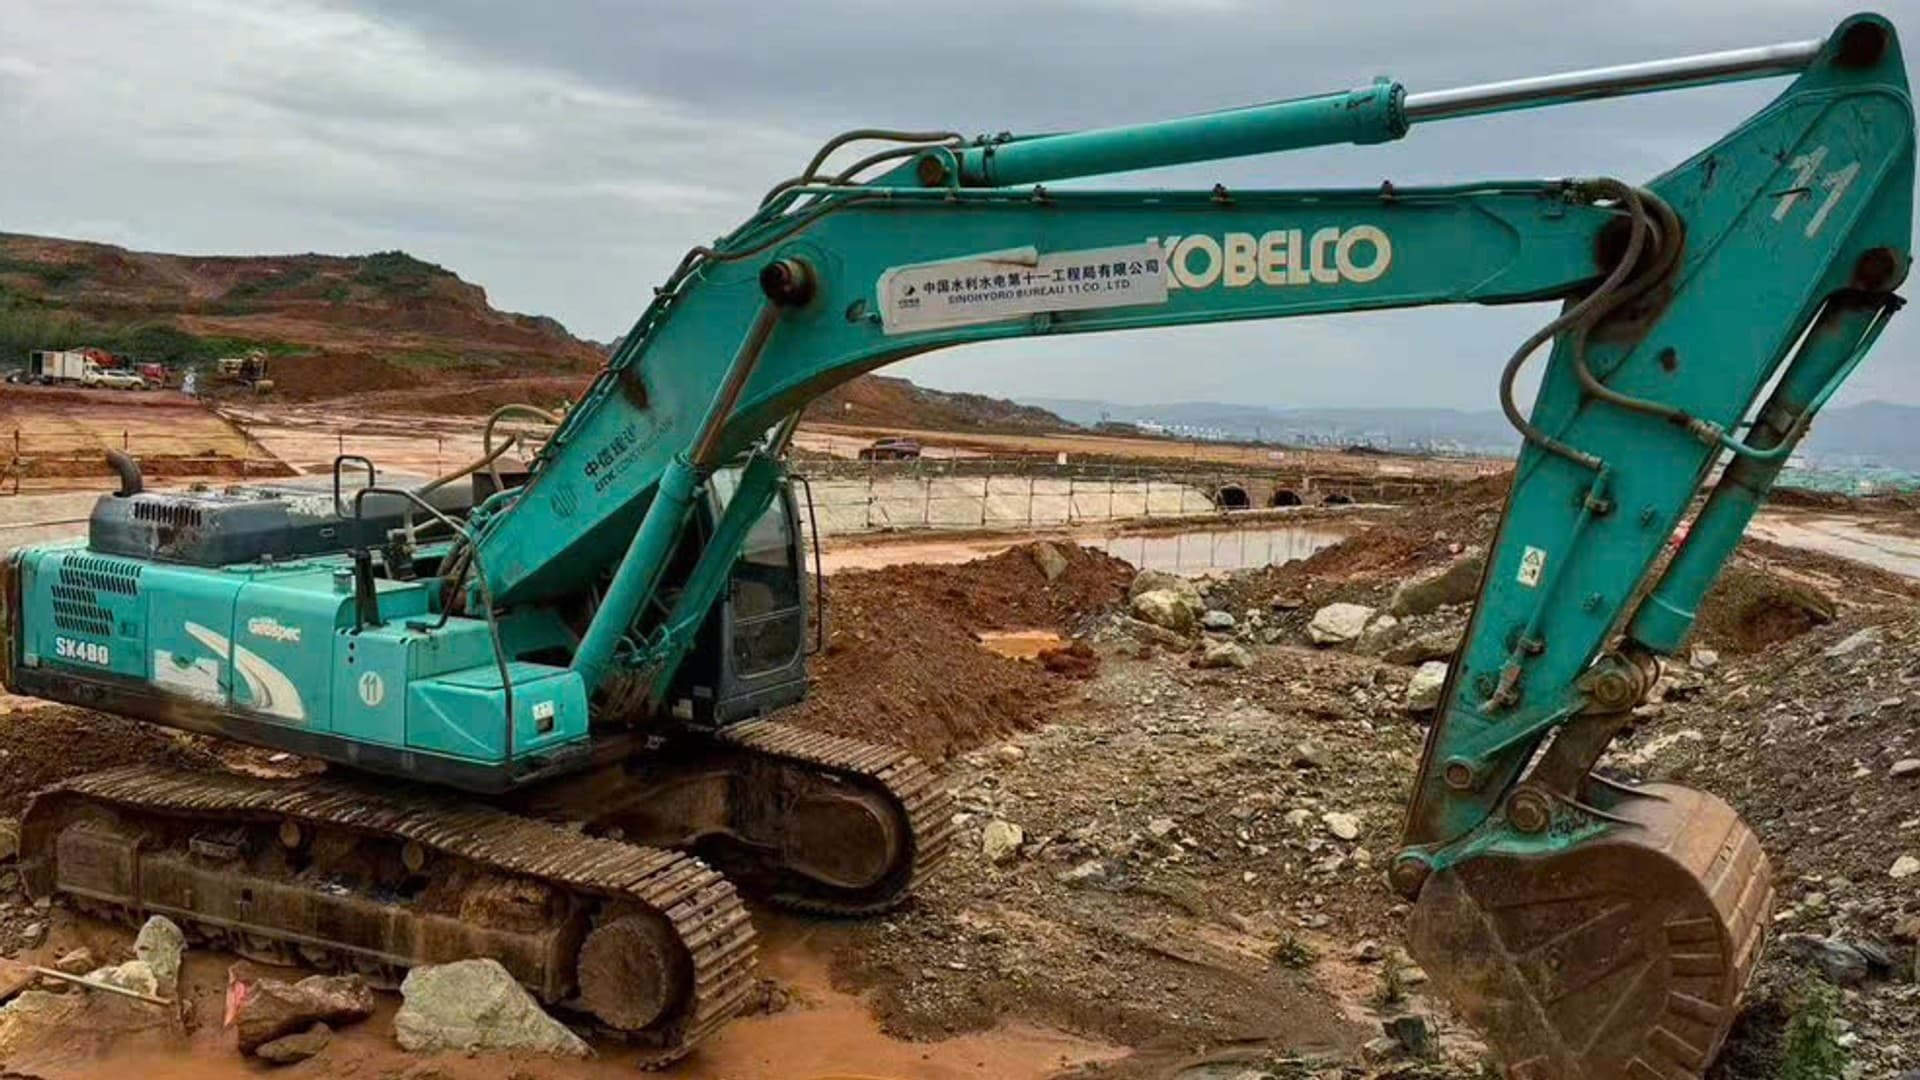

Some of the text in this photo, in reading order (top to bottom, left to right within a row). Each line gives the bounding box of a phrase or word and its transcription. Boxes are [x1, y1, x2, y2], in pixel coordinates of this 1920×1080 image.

[1771, 145, 1861, 239] 11
[923, 258, 1160, 295] 中国水利水电第十一工程局有限公司
[948, 289, 1015, 304] SINOHYDRO
[1015, 283, 1065, 299] BUREAU
[1068, 284, 1080, 294] 11
[55, 636, 109, 665] SK480
[362, 674, 378, 702] 11
